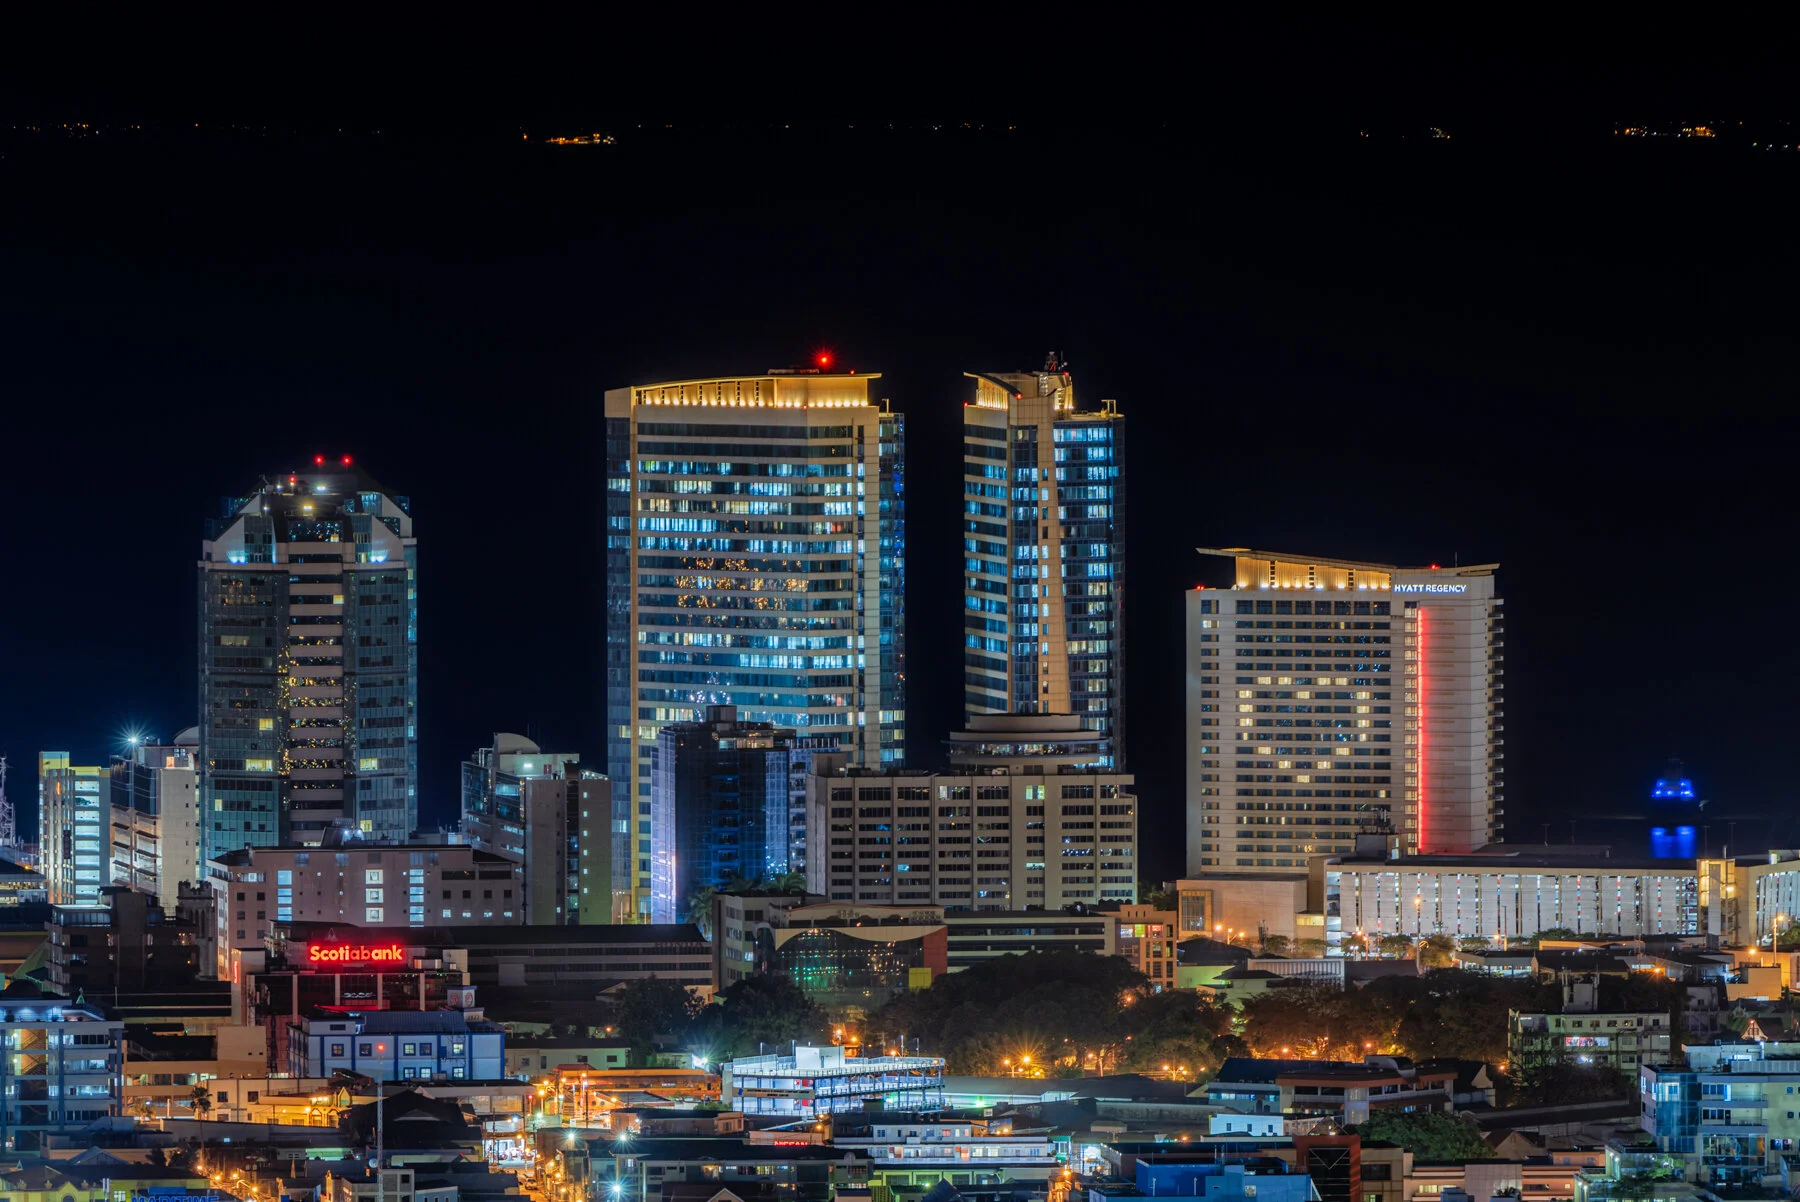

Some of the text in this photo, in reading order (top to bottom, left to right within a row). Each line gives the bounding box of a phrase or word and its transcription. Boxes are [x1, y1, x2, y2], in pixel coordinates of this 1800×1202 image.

[1394, 584, 1467, 593] HYATT REGENCY
[310, 945, 403, 961] Scotiabank
